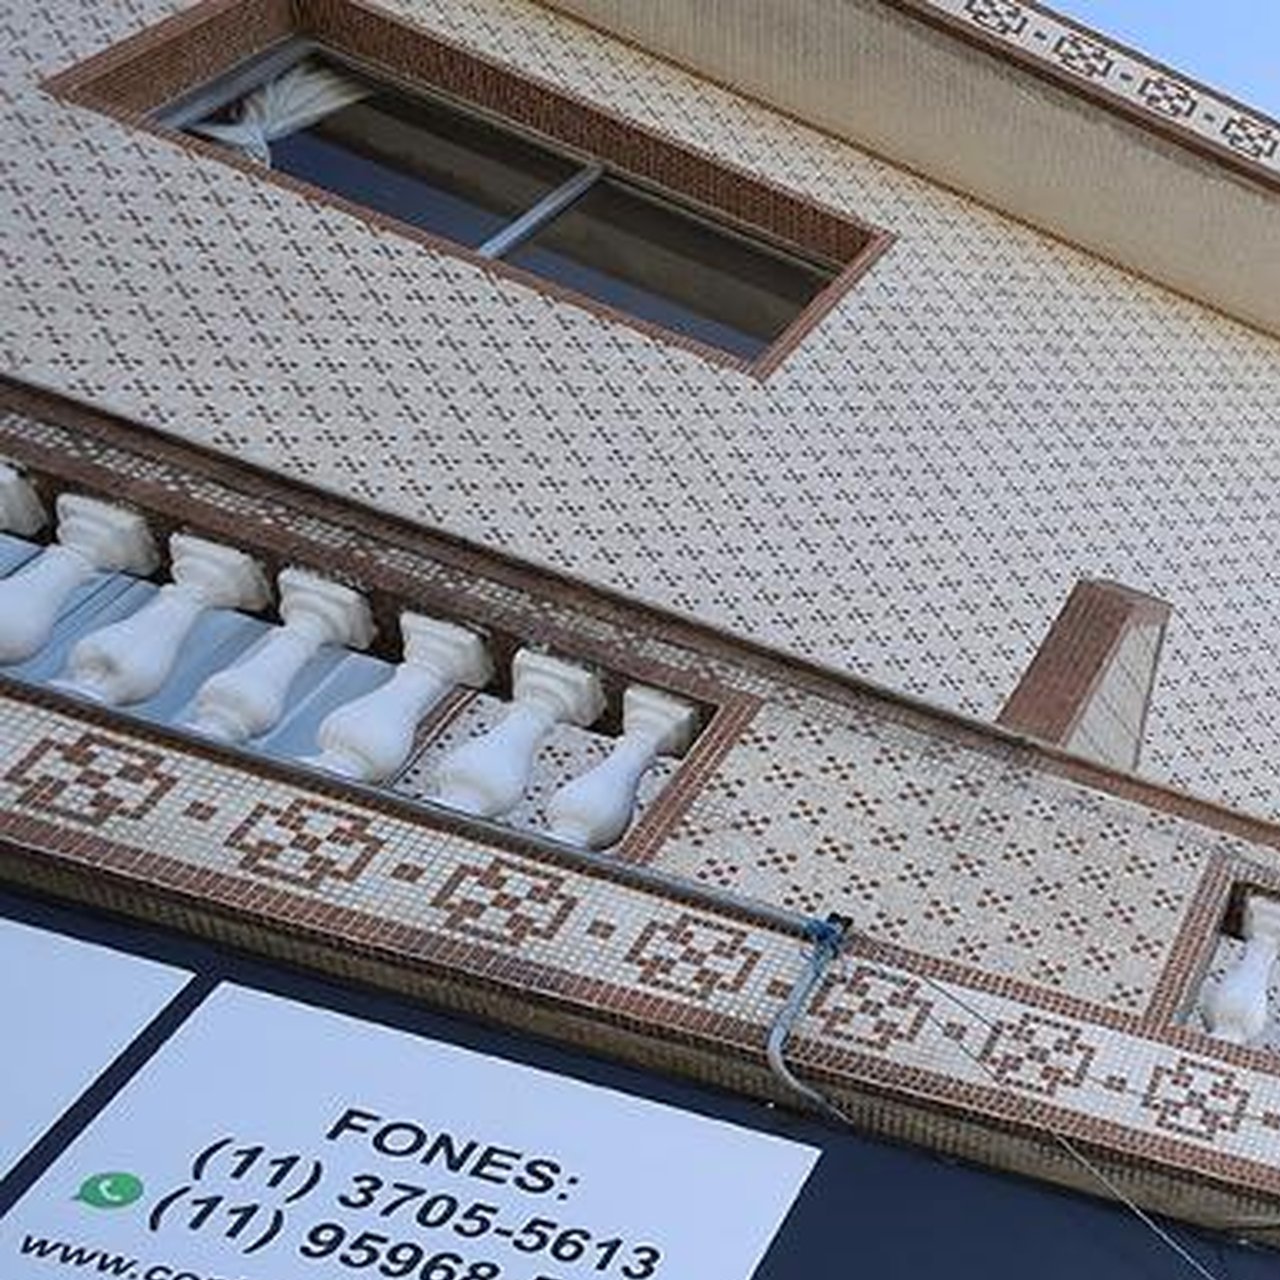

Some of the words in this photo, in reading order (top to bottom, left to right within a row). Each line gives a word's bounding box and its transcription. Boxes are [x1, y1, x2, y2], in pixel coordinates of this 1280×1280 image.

[327, 1109, 580, 1202] FONES:
[149, 1186, 285, 1254] (11)
[193, 1138, 323, 1218] (11)
[338, 1174, 661, 1280] 3705-5613
